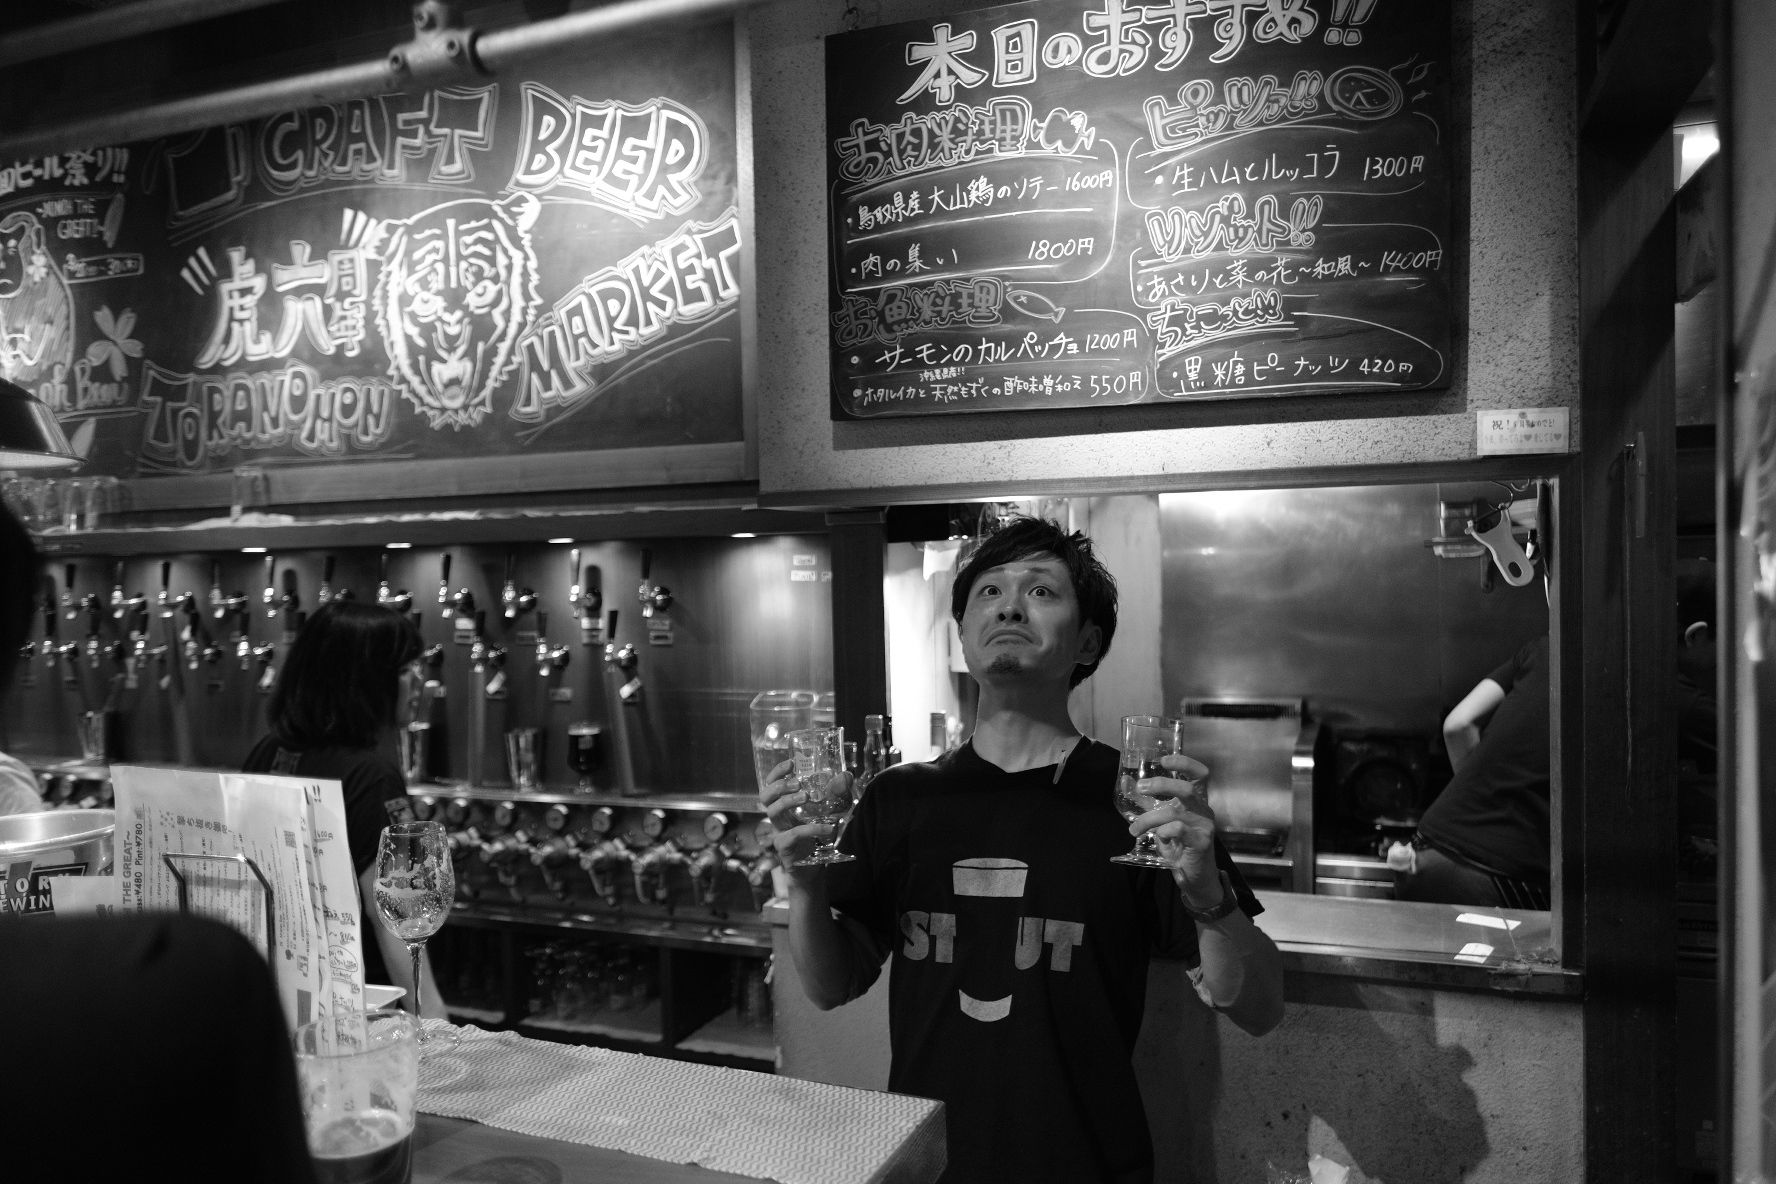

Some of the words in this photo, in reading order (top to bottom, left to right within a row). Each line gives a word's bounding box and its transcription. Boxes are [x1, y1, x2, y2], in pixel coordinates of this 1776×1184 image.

[895, 0, 1377, 104] 本日のおすすめ!!
[261, 83, 499, 196] CRAFT
[505, 82, 710, 223] BEER
[834, 96, 1032, 183] お肉料理
[1065, 169, 1114, 192] 1600円
[1171, 144, 1340, 197] 生ハムとルッコラ
[1363, 155, 1425, 181] 1300円
[860, 243, 958, 280] 肉の集い
[1027, 237, 1095, 260] 1800円
[1379, 249, 1443, 274] 1400円
[508, 207, 743, 423] MARKET
[831, 276, 1003, 347] お魚料理
[874, 332, 1080, 372] サーモンのカルパッチョ
[1085, 328, 1137, 353] 1200円
[1185, 351, 1349, 388] 黒糖ピーナッツ
[1359, 357, 1414, 375] 420円
[1090, 370, 1142, 398] 550円
[122, 881, 132, 904] THE
